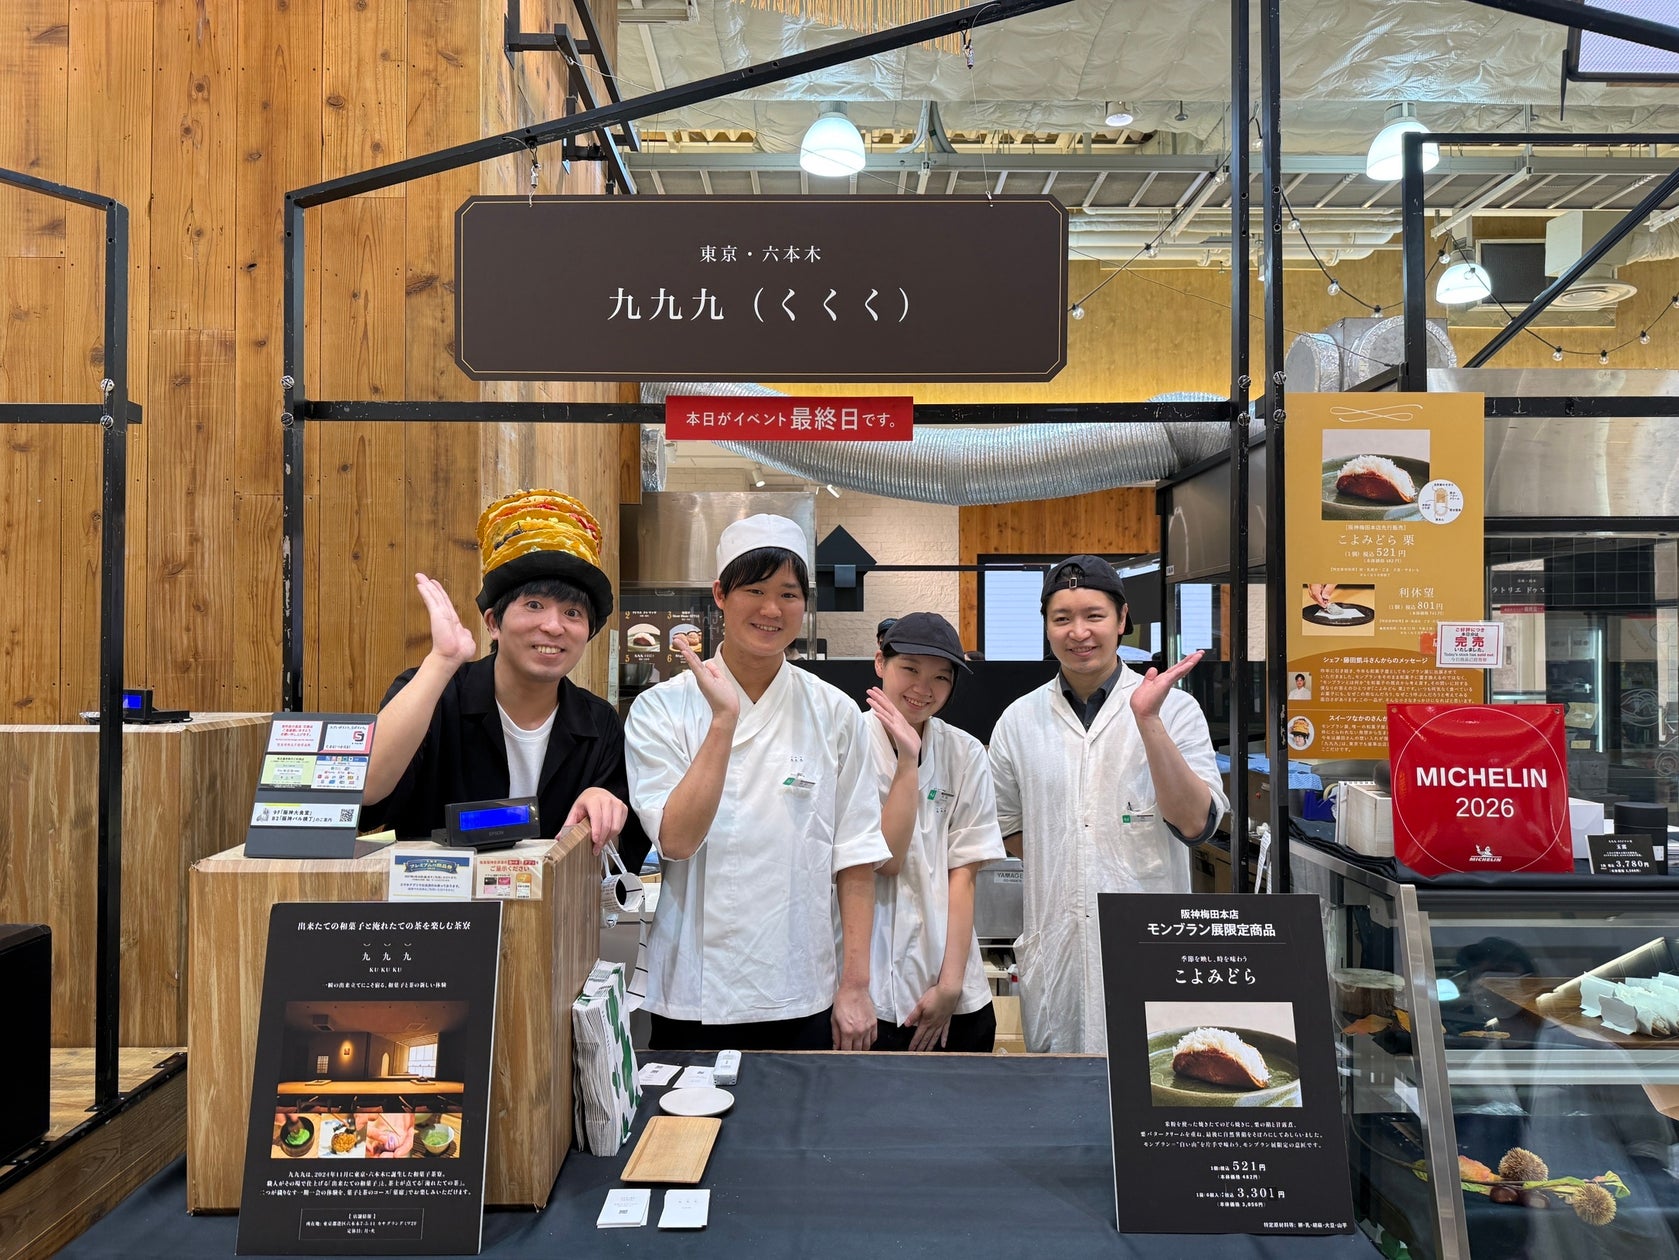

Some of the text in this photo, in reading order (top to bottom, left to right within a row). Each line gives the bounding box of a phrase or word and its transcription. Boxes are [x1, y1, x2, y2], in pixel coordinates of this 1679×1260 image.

[700, 244, 822, 263] 東京・六本木
[607, 286, 909, 323] 九九九（くくく）
[685, 406, 896, 431] 本日がイベント最終日です。
[1338, 534, 1415, 546] こよみどら 栗
[1376, 547, 1406, 557] 521円
[1399, 587, 1435, 598] 利休望
[1417, 601, 1444, 610] 801円
[1455, 636, 1485, 648] 完売
[1416, 766, 1548, 788] MICHELIN
[1456, 797, 1515, 819] 2026
[1468, 855, 1503, 863] MICHELIN
[1180, 909, 1239, 920] 阪神梅田本店
[1147, 922, 1276, 937] モンブラン展限定商品
[361, 951, 412, 961] 九九九
[1181, 955, 1248, 963] 季節を映し、時を味わう
[1175, 967, 1256, 985] こよみどら
[1232, 1160, 1266, 1172] 521円
